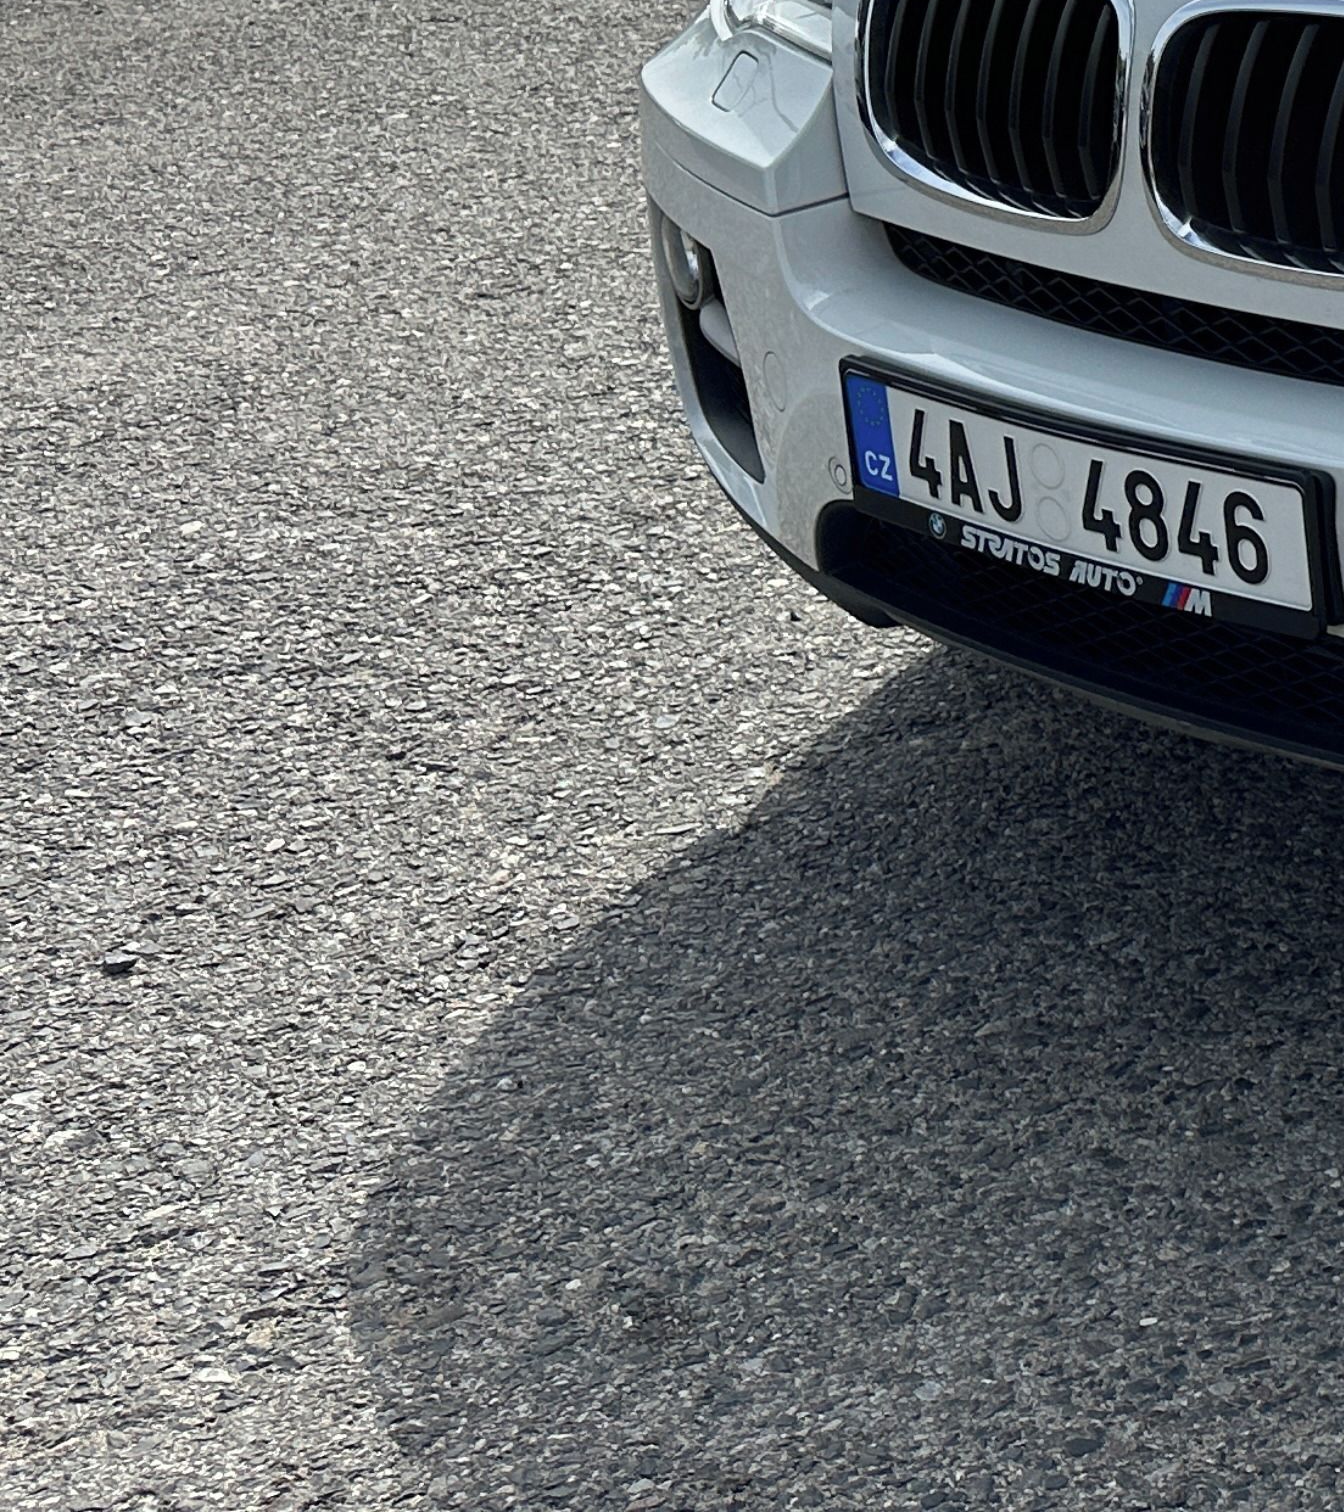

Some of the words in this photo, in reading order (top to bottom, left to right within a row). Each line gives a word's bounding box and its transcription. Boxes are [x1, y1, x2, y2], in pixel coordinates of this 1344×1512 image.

[864, 450, 894, 482] CZ
[909, 408, 1023, 523] 4AJ
[1082, 458, 1269, 586] 4846
[960, 525, 1061, 577] STRATOS
[1068, 560, 1137, 597] AUTO
